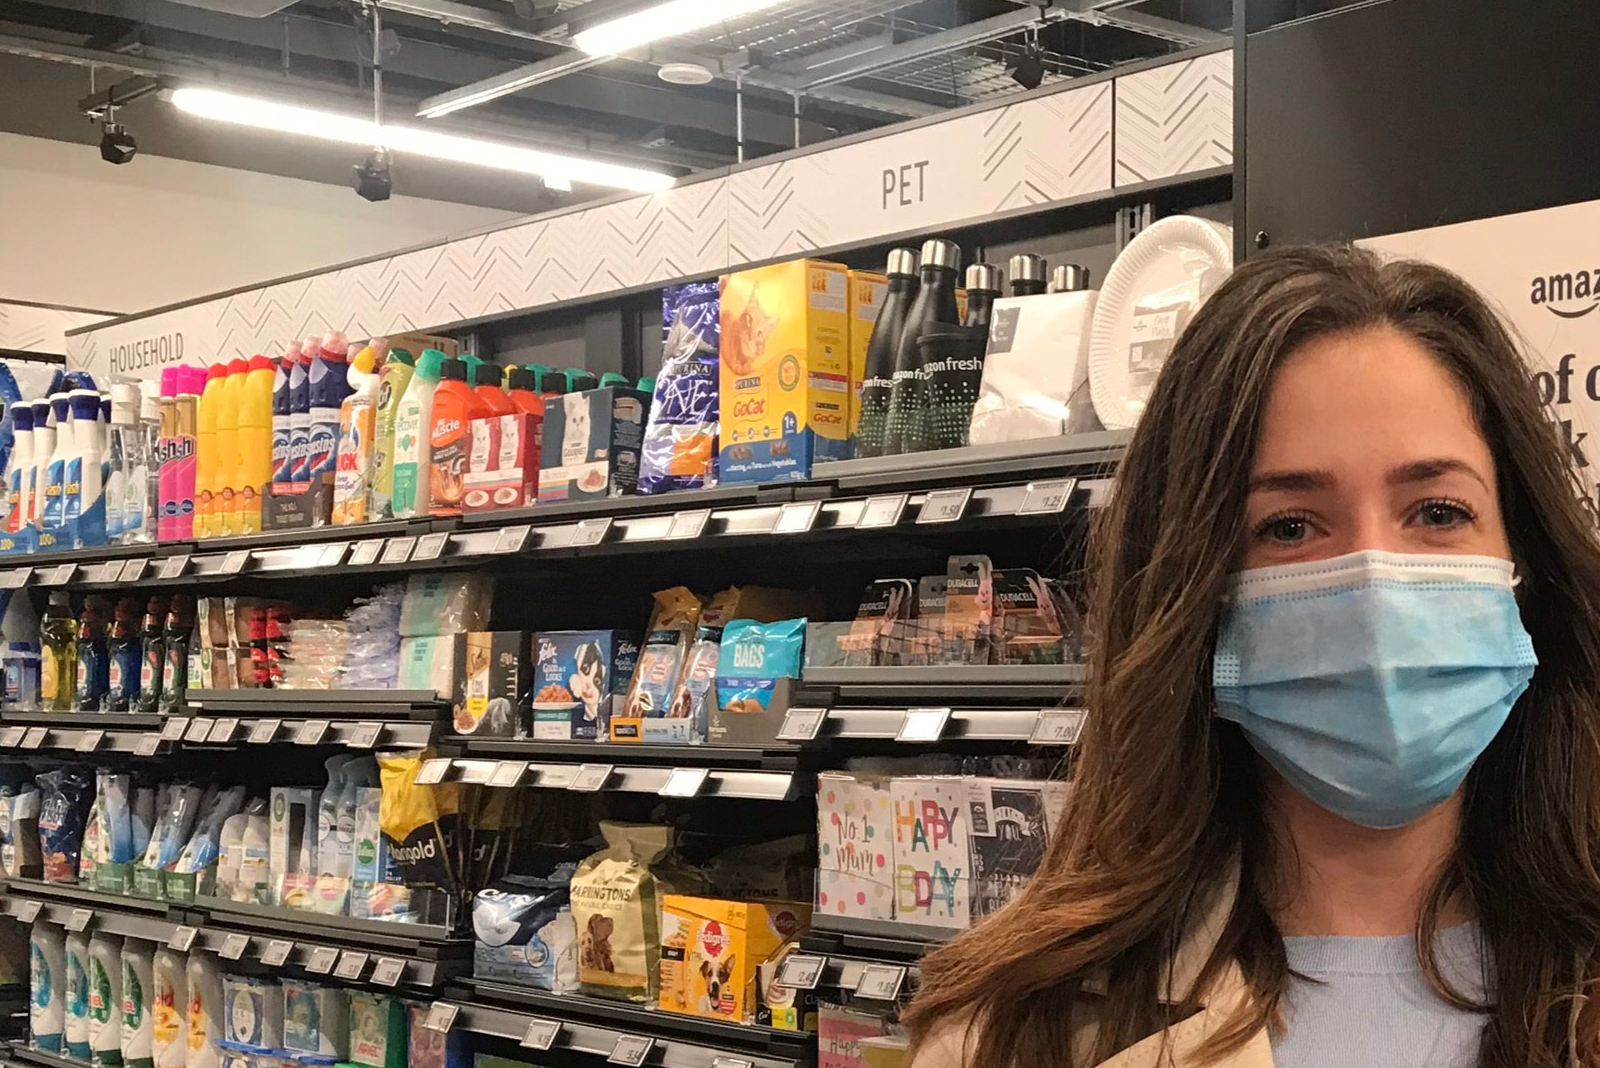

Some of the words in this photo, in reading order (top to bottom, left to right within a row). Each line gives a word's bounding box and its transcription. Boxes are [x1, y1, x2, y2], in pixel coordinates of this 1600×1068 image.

[881, 160, 930, 210] PET
[109, 332, 184, 373] HOUSEHOLD
[946, 356, 983, 371] fresh
[1533, 353, 1577, 408] of
[947, 578, 979, 588] DURACELL
[999, 591, 1036, 603] DURACELL
[733, 643, 765, 669] BAGS
[896, 860, 963, 918] BDAY
